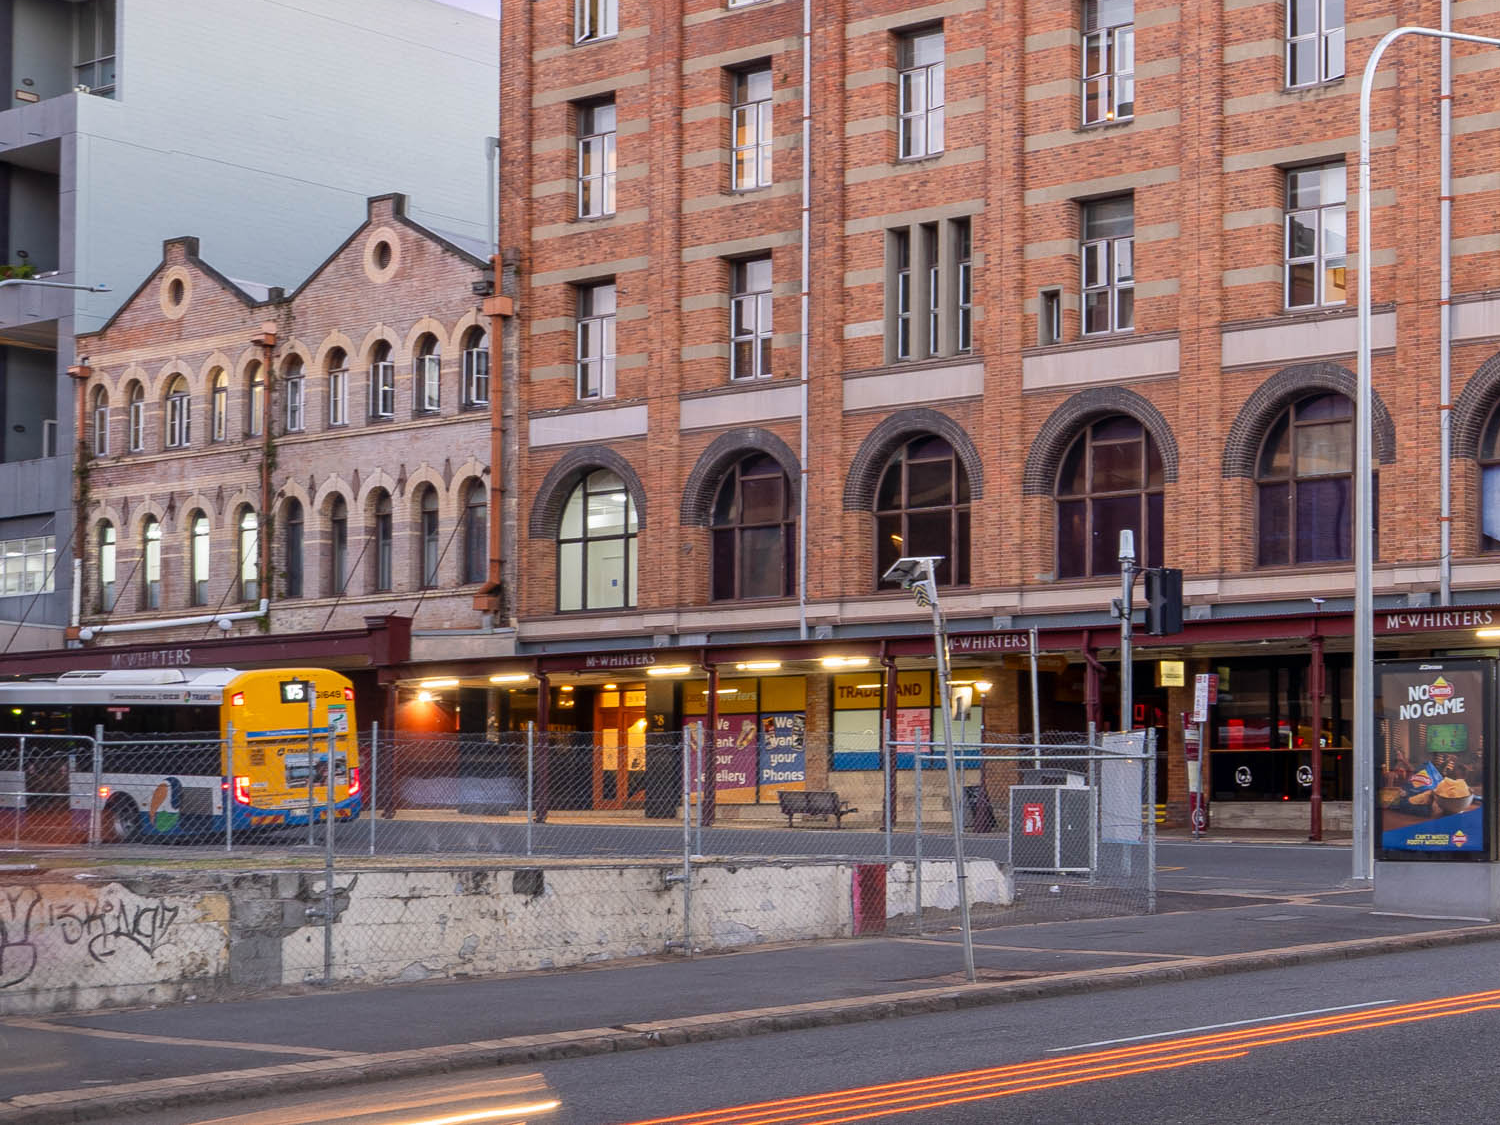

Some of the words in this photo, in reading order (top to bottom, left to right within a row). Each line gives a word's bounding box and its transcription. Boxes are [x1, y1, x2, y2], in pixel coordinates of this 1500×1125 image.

[838, 685, 880, 699] TRADE
[1408, 684, 1430, 702] NO
[1400, 703, 1421, 720] NO
[1423, 697, 1465, 717] GAME
[774, 716, 793, 728] We
[716, 736, 734, 748] ant
[770, 753, 797, 766] your
[762, 768, 805, 781] Phones
